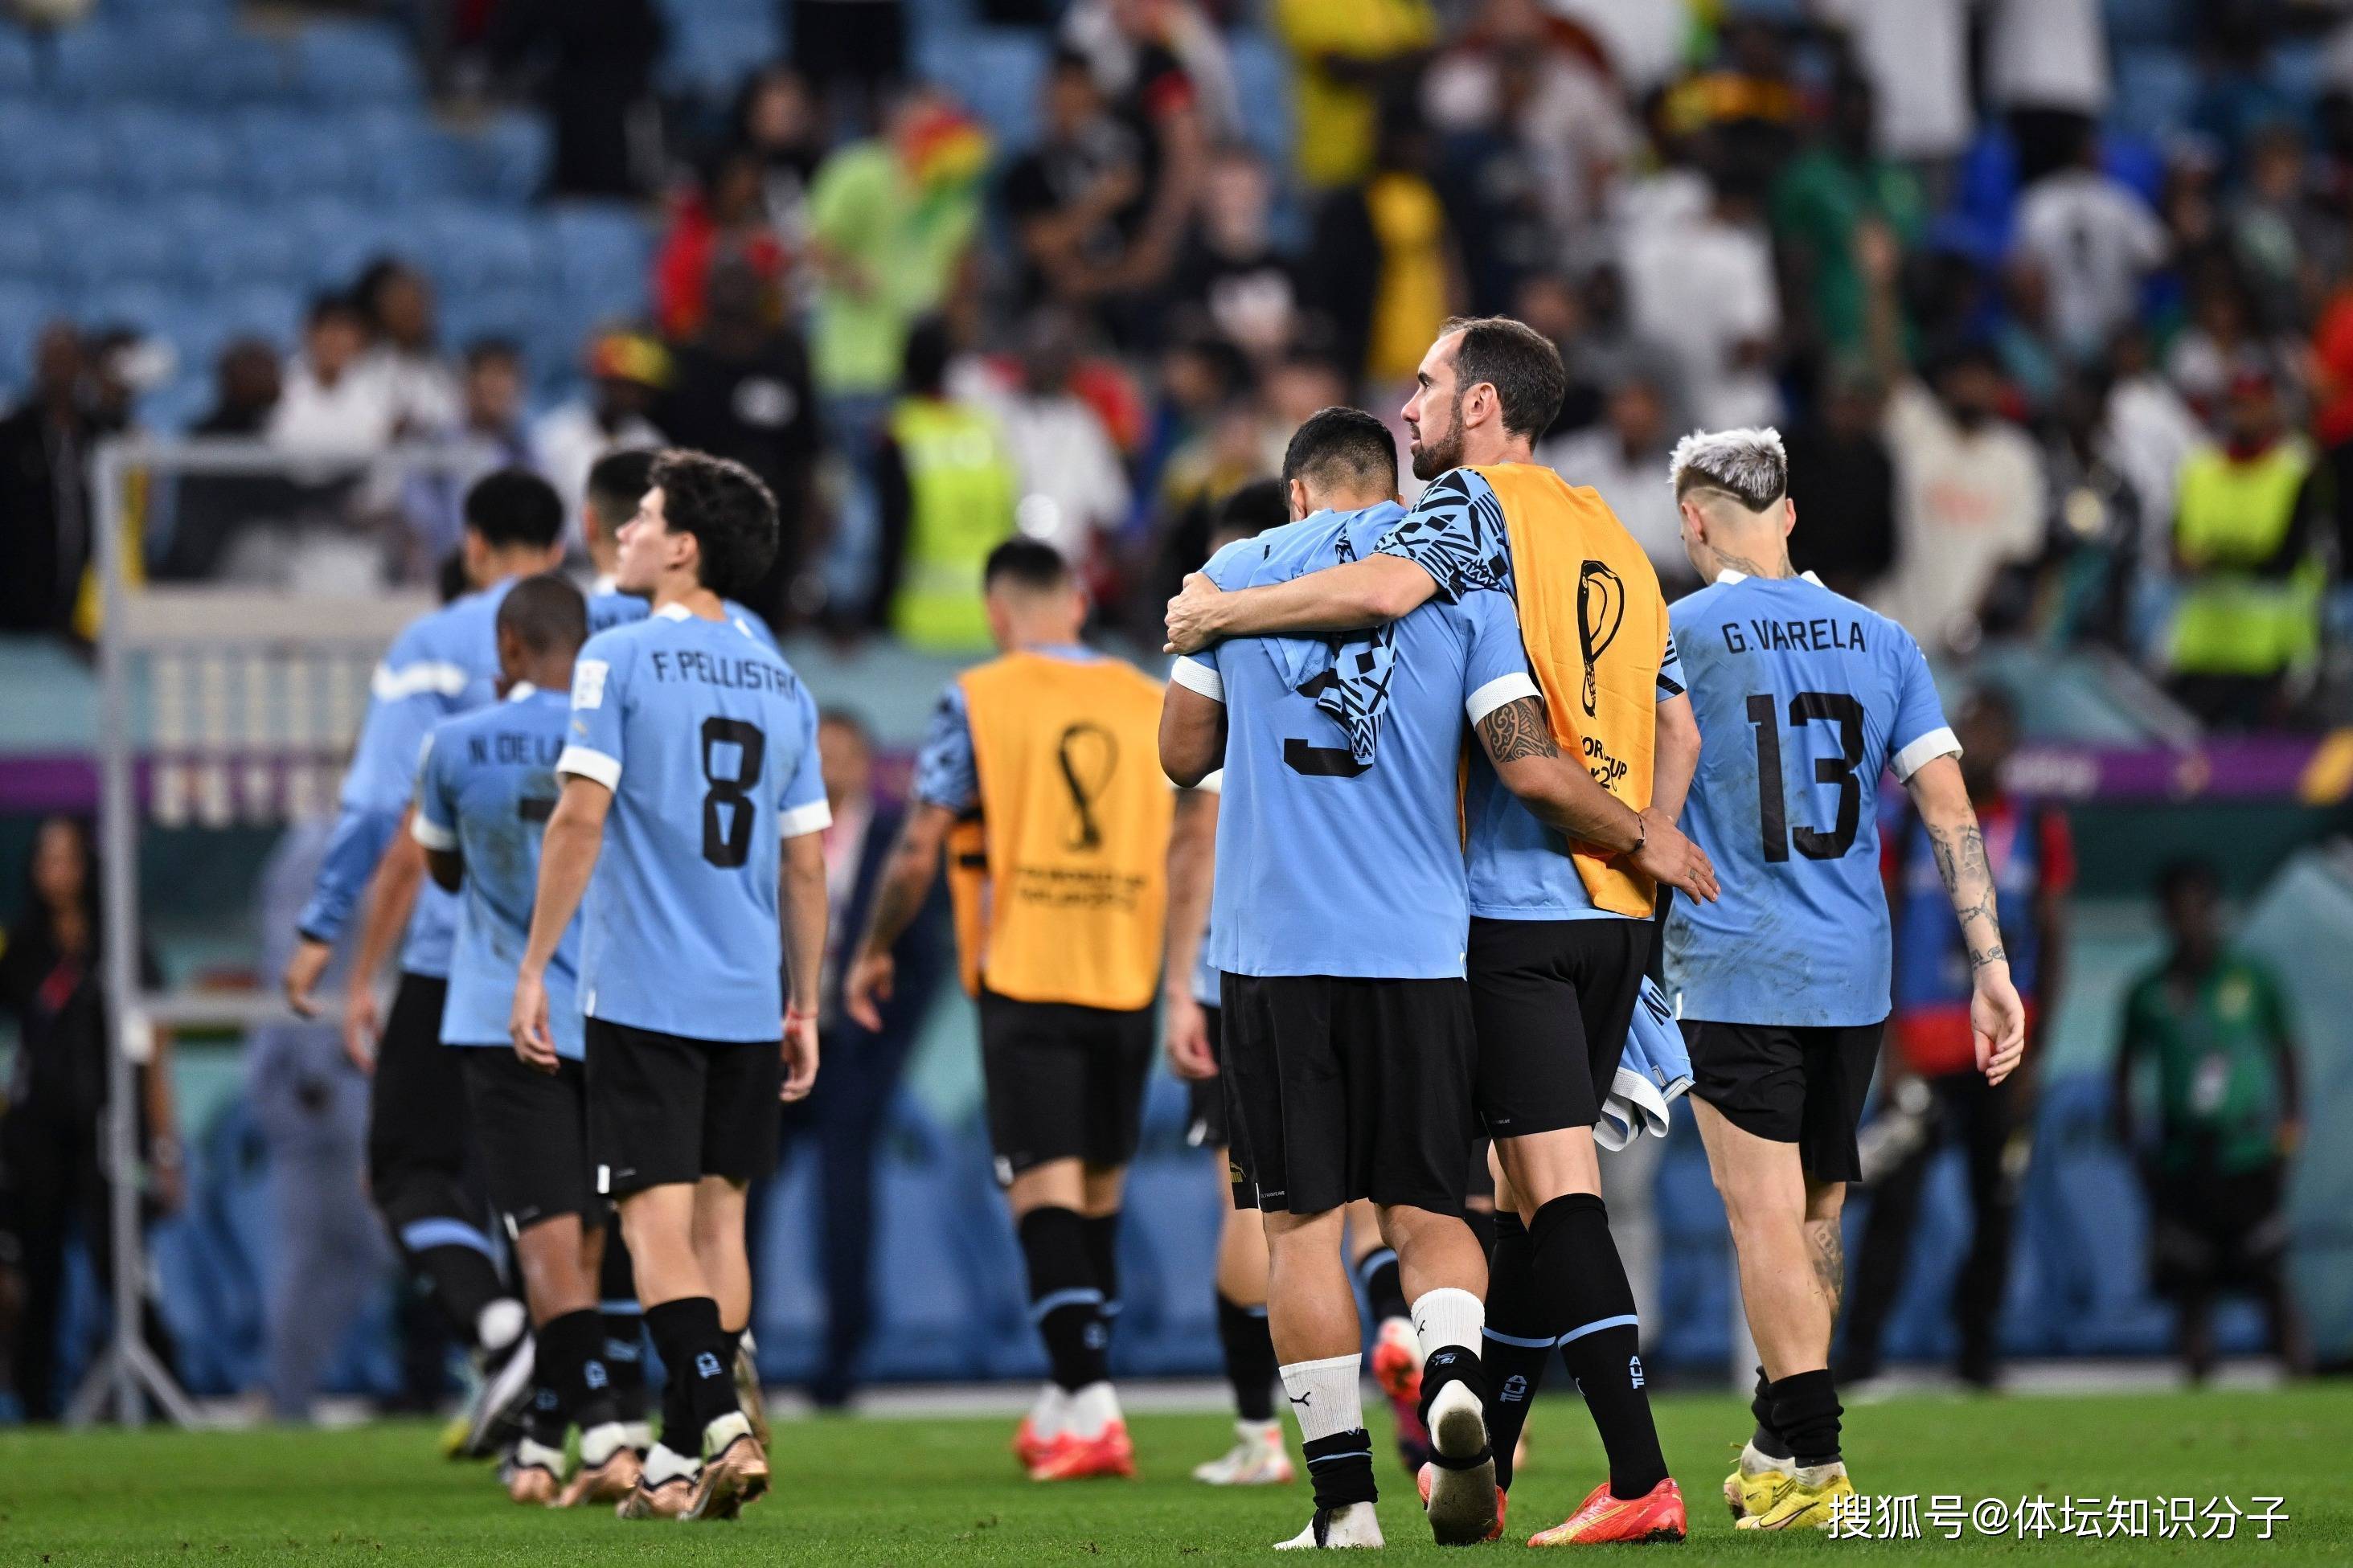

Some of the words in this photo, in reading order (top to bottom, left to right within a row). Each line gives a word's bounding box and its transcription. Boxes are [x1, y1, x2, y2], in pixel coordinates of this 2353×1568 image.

[1722, 619, 1866, 654] G.VARELA
[701, 716, 766, 869] 8
[1746, 691, 1865, 862] 13
[1500, 1375, 1527, 1402] AUF
[1629, 1355, 1645, 1390] AUF
